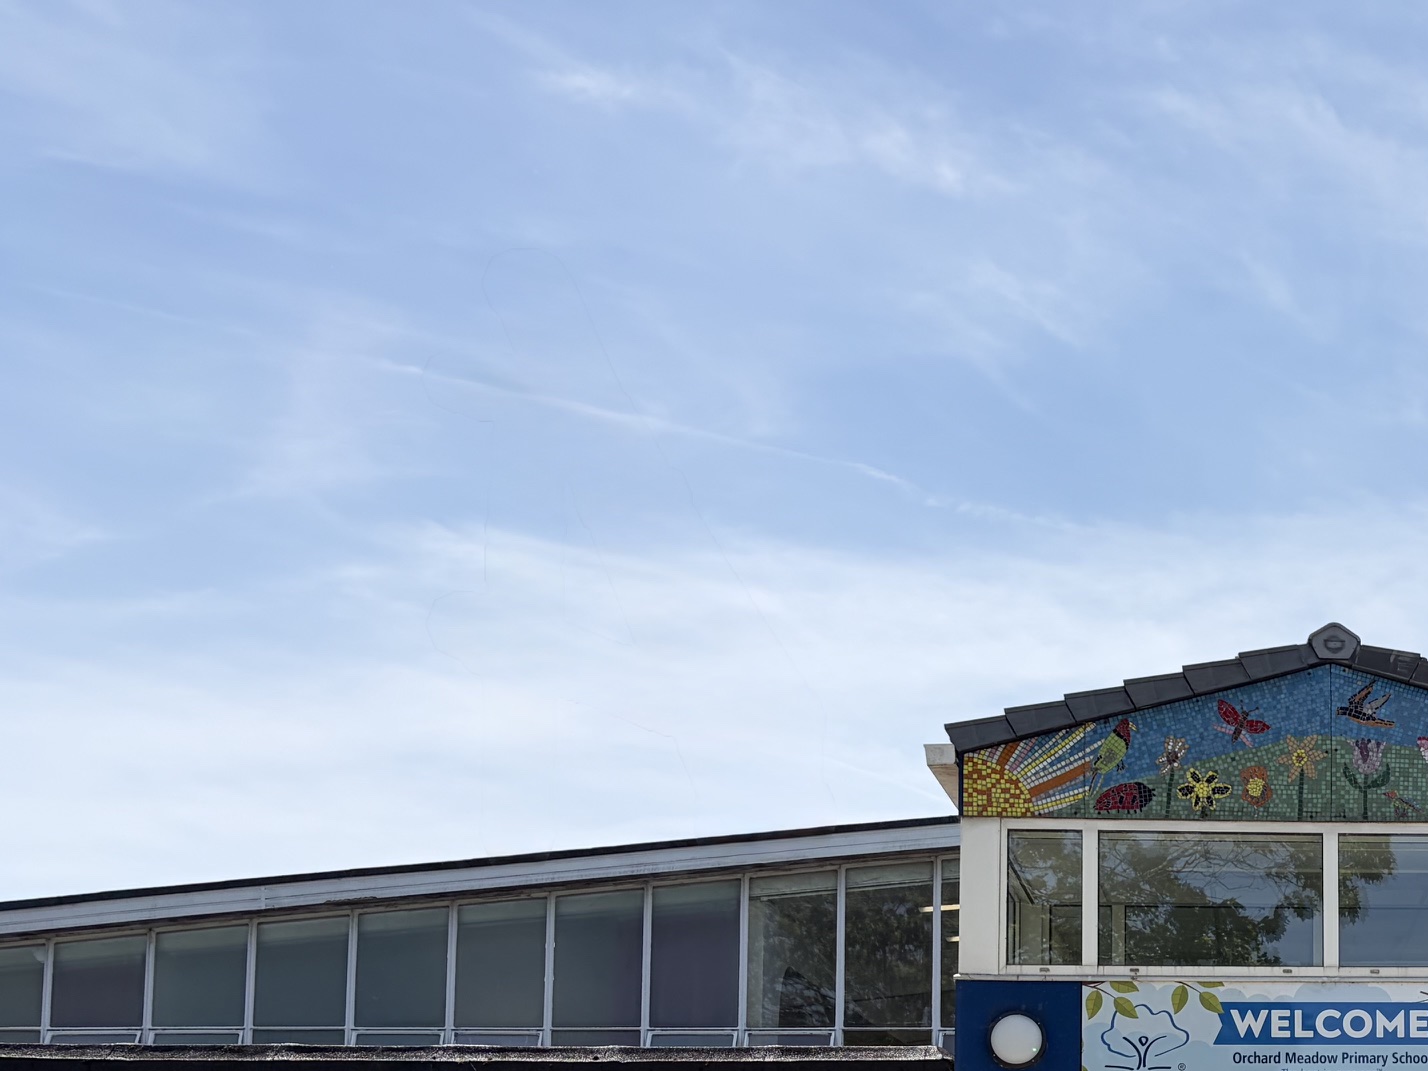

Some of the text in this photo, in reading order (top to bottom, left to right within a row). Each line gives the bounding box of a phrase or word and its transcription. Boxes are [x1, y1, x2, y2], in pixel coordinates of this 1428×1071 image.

[1230, 1008, 1428, 1039] WELCOME
[1232, 1052, 1281, 1064] Orchard
[1285, 1052, 1338, 1064] Meadow
[1341, 1052, 1388, 1067] Primary
